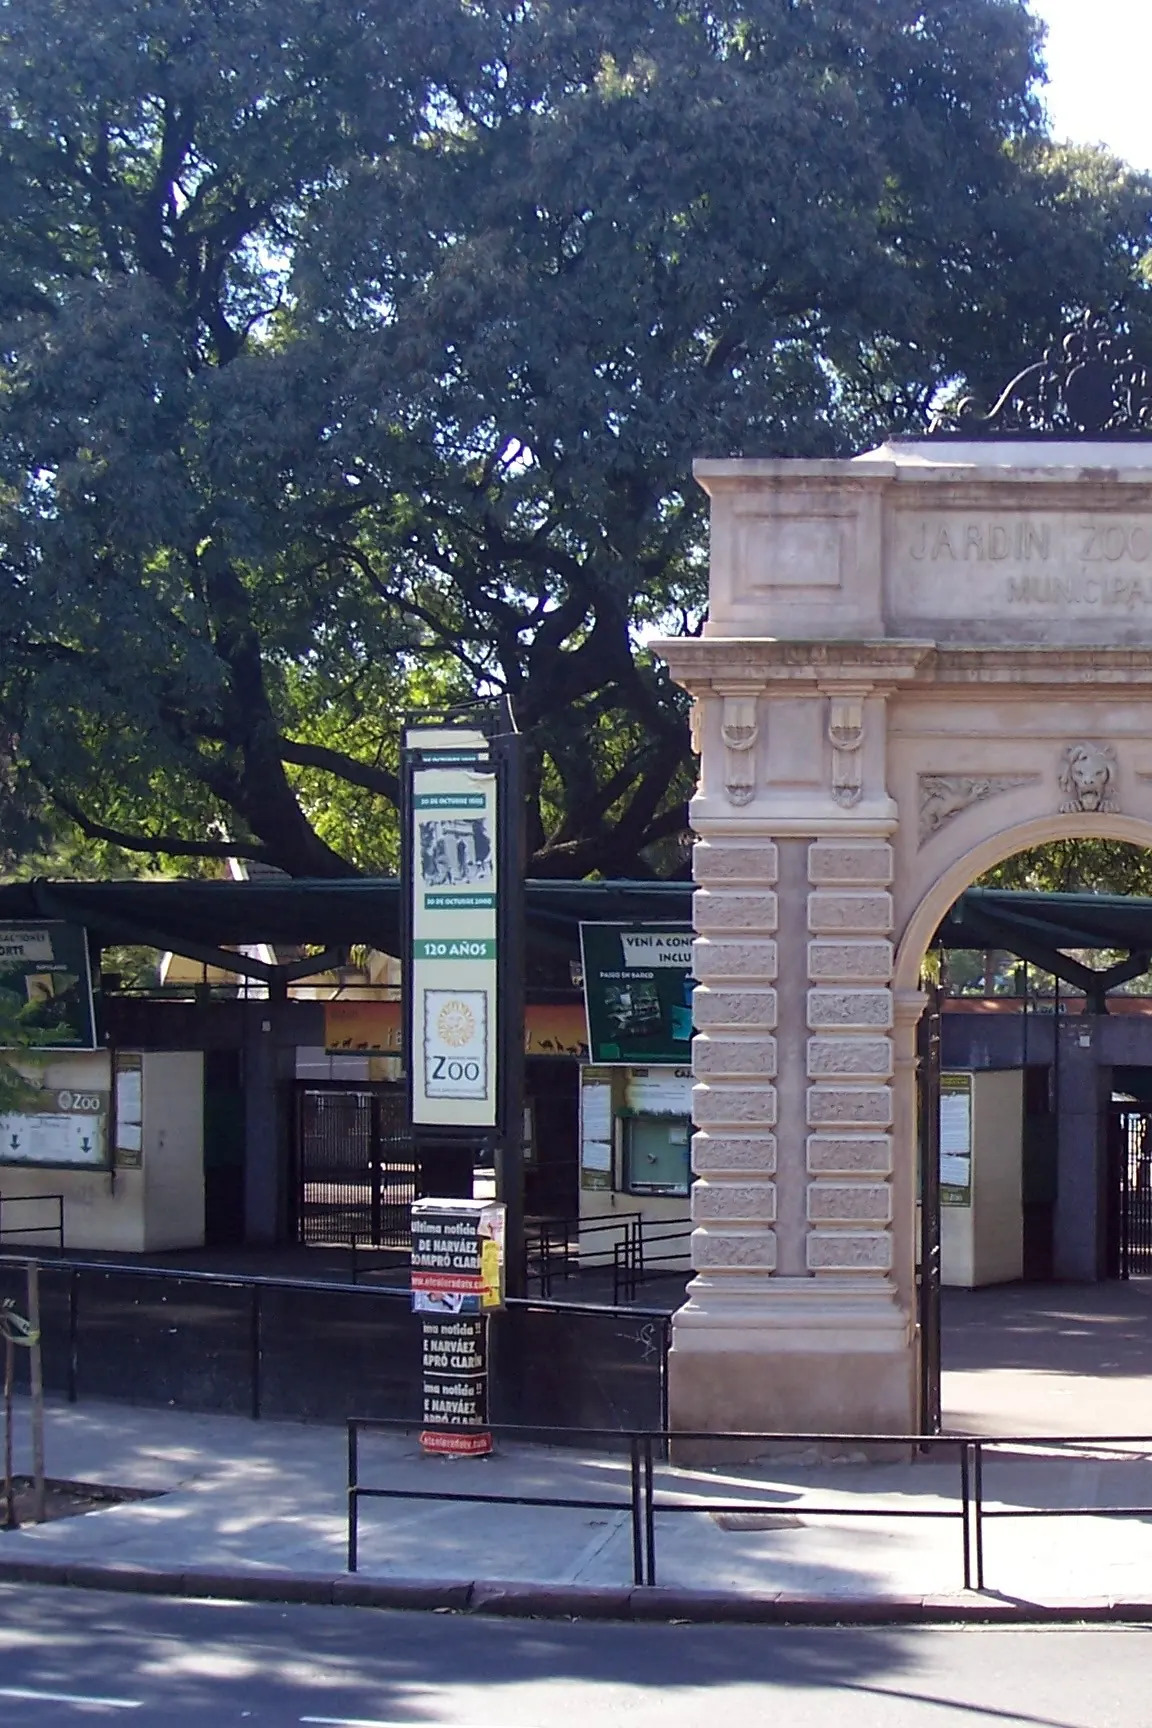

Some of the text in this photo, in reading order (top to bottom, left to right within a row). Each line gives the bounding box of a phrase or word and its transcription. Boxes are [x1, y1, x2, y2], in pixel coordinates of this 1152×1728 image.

[424, 940, 487, 955] 120 AÑOS
[655, 938, 665, 946] A
[444, 1222, 476, 1236] noticia
[418, 1238, 478, 1254] DE NARVÁEZ
[441, 1323, 474, 1336] noticia
[430, 1338, 475, 1354] NARVÁEZ
[442, 1384, 474, 1396] noticia
[431, 1398, 476, 1414] NARVÁEZ
